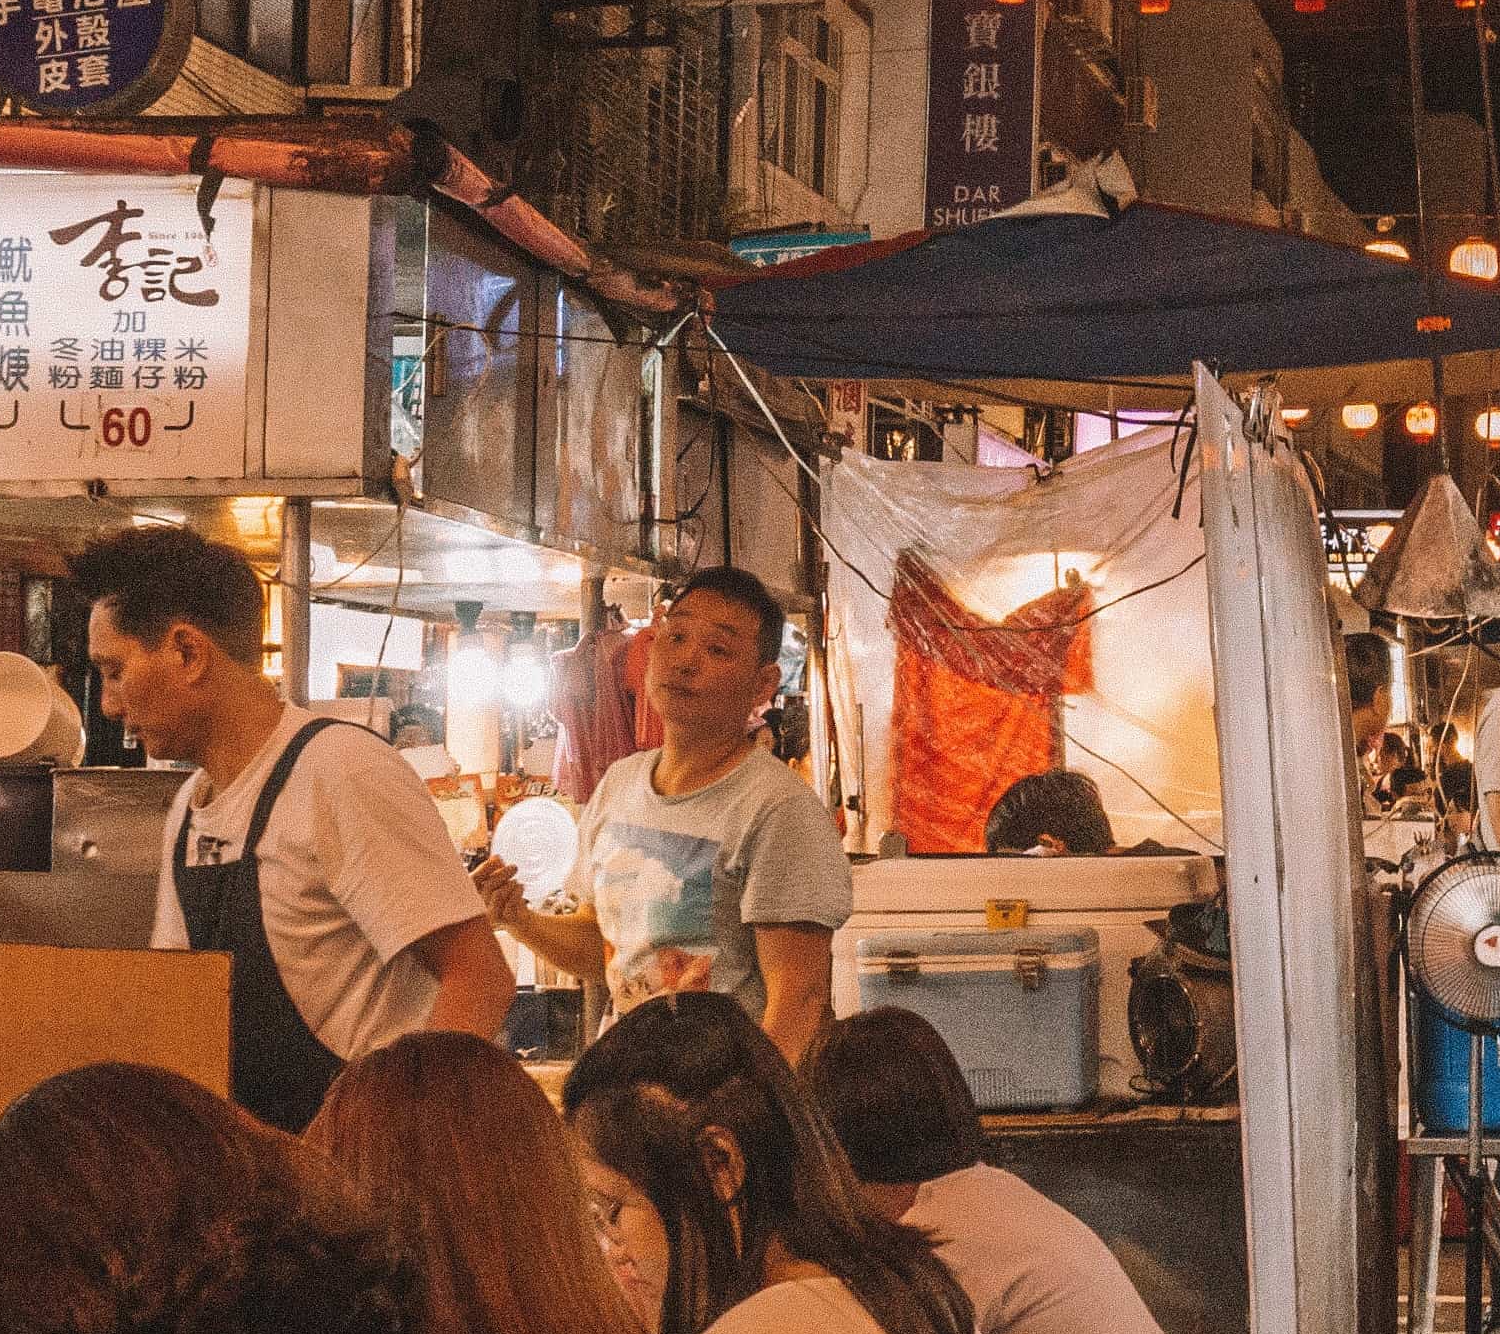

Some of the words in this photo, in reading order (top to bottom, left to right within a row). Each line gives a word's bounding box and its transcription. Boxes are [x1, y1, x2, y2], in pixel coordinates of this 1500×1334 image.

[34, 14, 110, 57] 外殼
[38, 54, 111, 94] 皮套
[953, 185, 1002, 204] DAR
[47, 199, 220, 307] 李記
[112, 309, 146, 333] 加
[48, 337, 83, 389] 冬粉
[90, 338, 125, 389] 油麵
[173, 337, 208, 389] 米粉
[102, 407, 152, 447] 60
